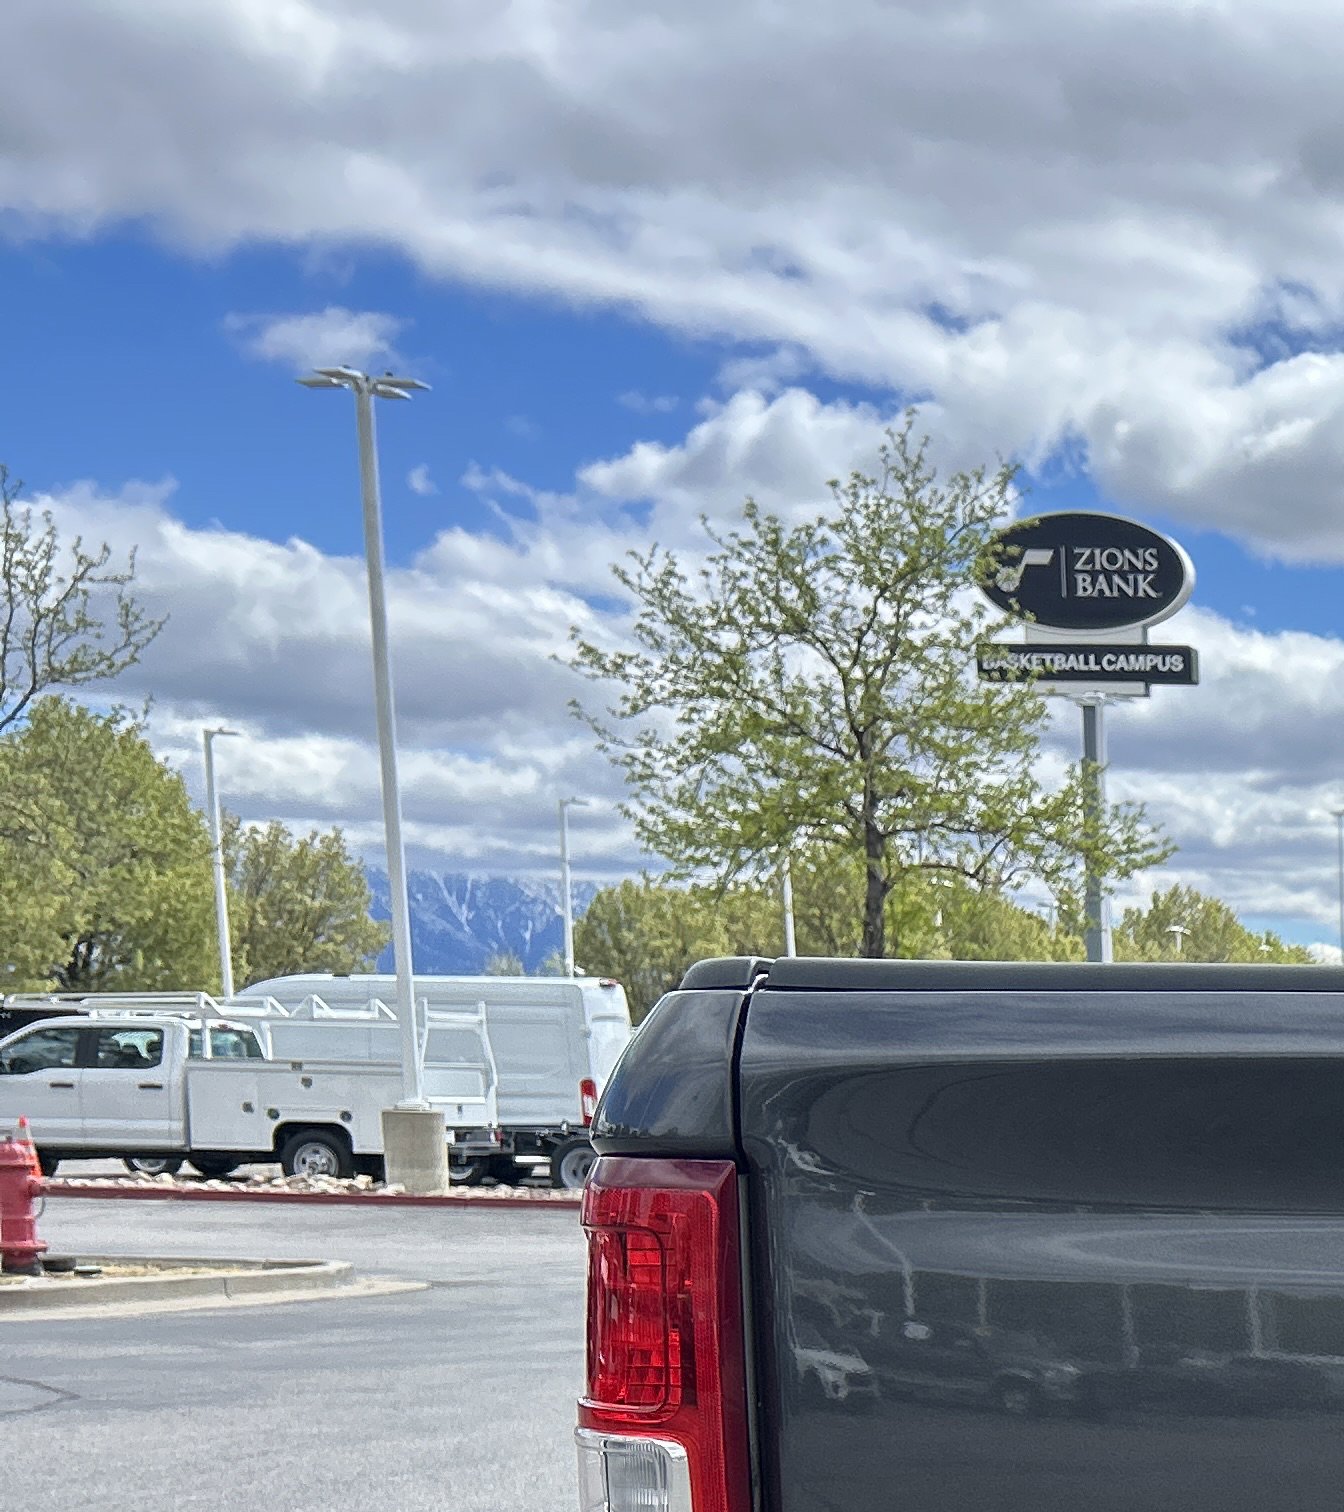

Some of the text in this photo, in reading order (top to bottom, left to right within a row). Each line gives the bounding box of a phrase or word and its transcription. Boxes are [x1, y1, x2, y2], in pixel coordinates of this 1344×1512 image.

[1073, 547, 1158, 571] ZIONS
[1074, 573, 1158, 598] BANK
[1101, 653, 1184, 672] CAMPUS
